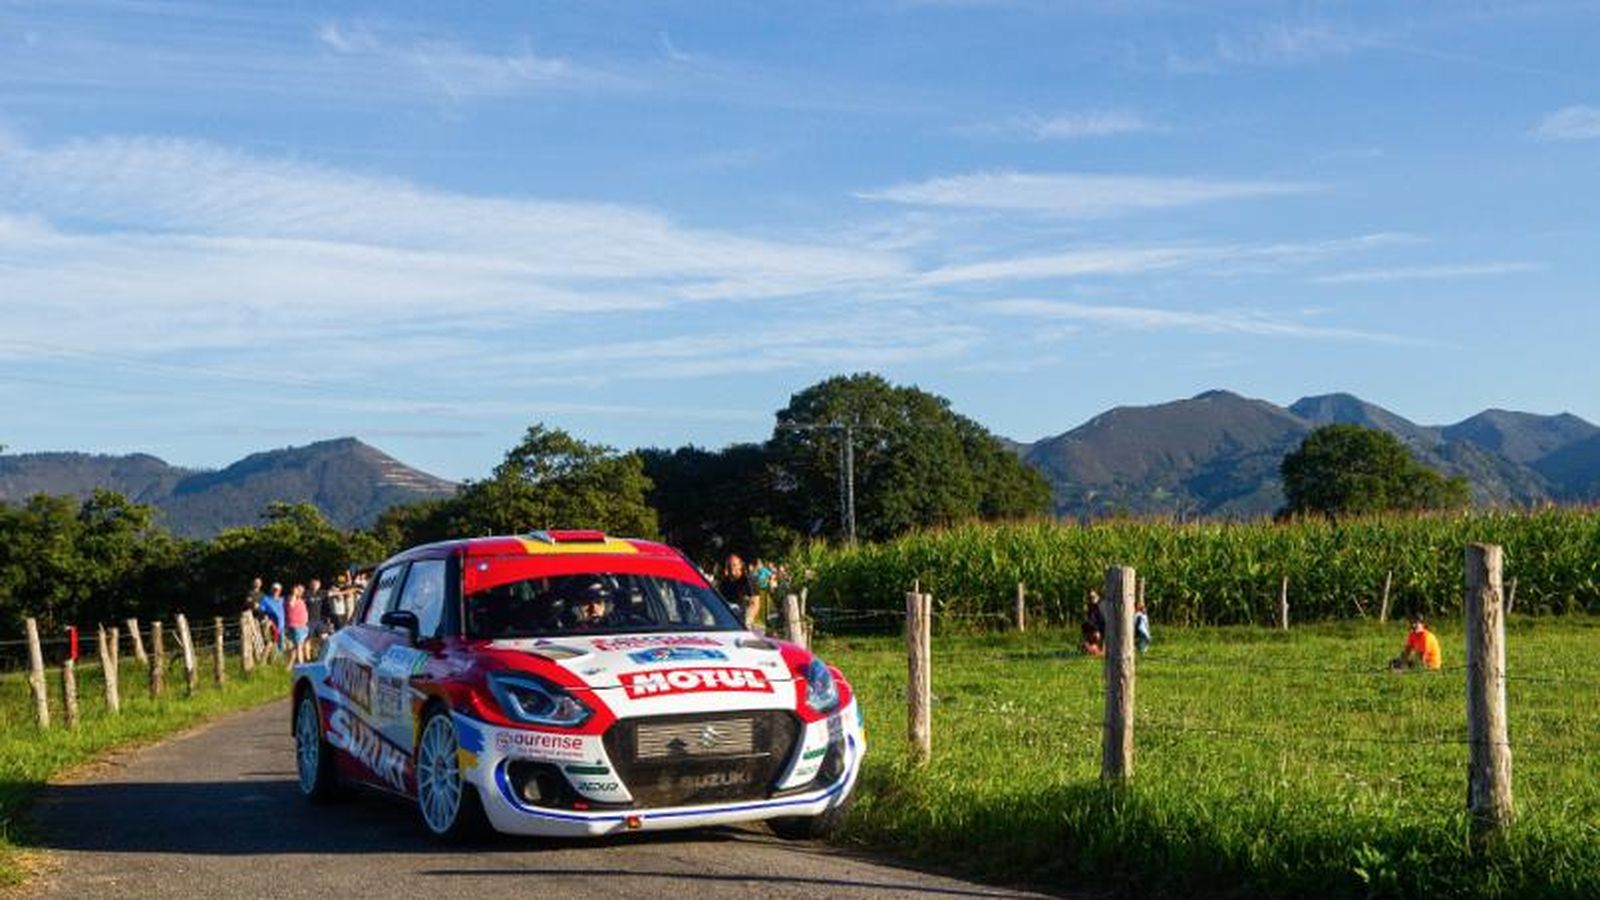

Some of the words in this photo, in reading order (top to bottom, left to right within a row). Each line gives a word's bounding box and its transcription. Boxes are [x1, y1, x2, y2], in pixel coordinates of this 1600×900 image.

[632, 670, 766, 694] MOTUL
[326, 709, 408, 793] SUZUKI
[514, 733, 583, 749] ourense
[681, 771, 752, 787] SUZUKI
